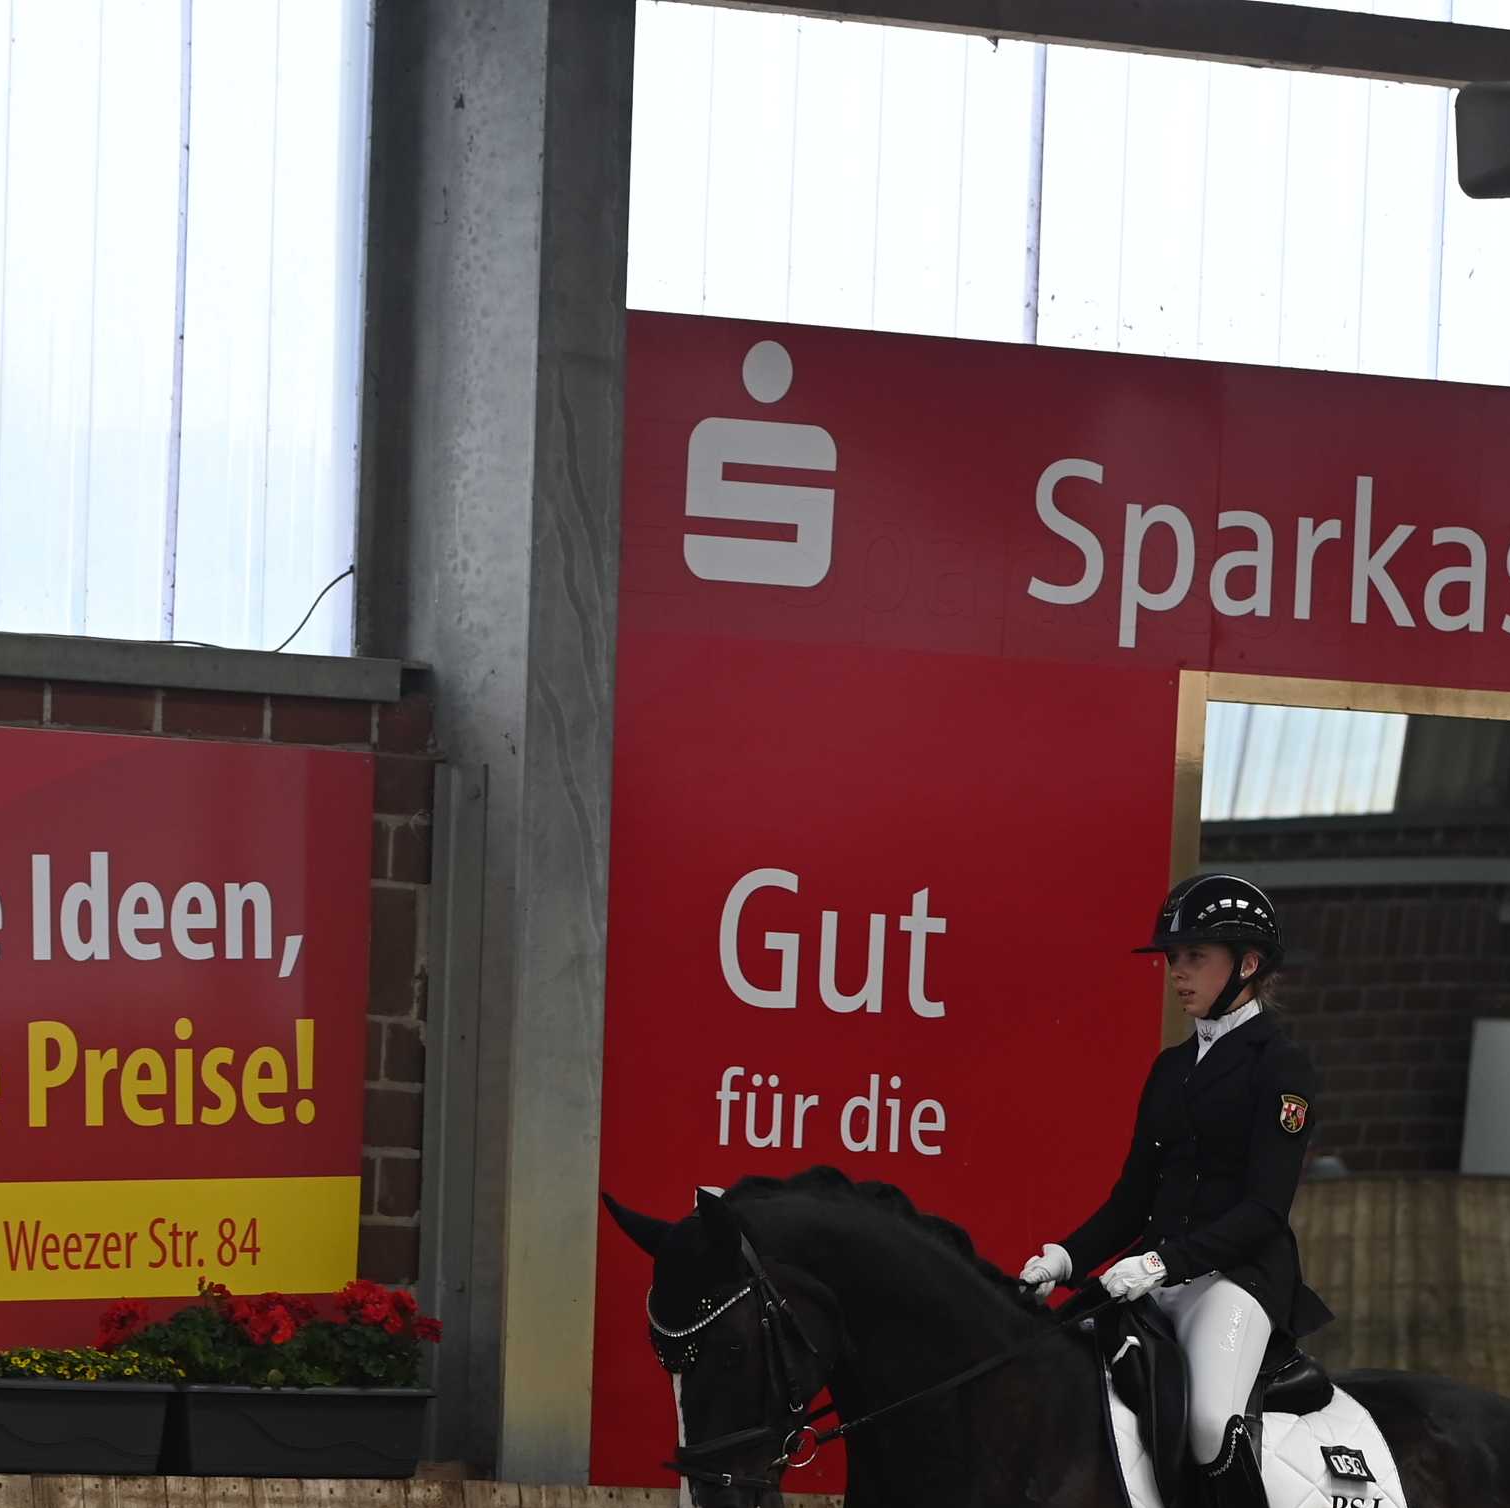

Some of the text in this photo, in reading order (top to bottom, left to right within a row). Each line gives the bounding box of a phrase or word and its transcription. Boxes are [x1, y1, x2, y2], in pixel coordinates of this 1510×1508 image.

[32, 852, 302, 977] Ideen,
[720, 868, 946, 1017] Gut
[28, 1018, 315, 1127] Preise!
[716, 1067, 945, 1155] für die
[3, 1220, 137, 1271] Weezer
[149, 1218, 204, 1268] Str.
[217, 1218, 260, 1266] 84
